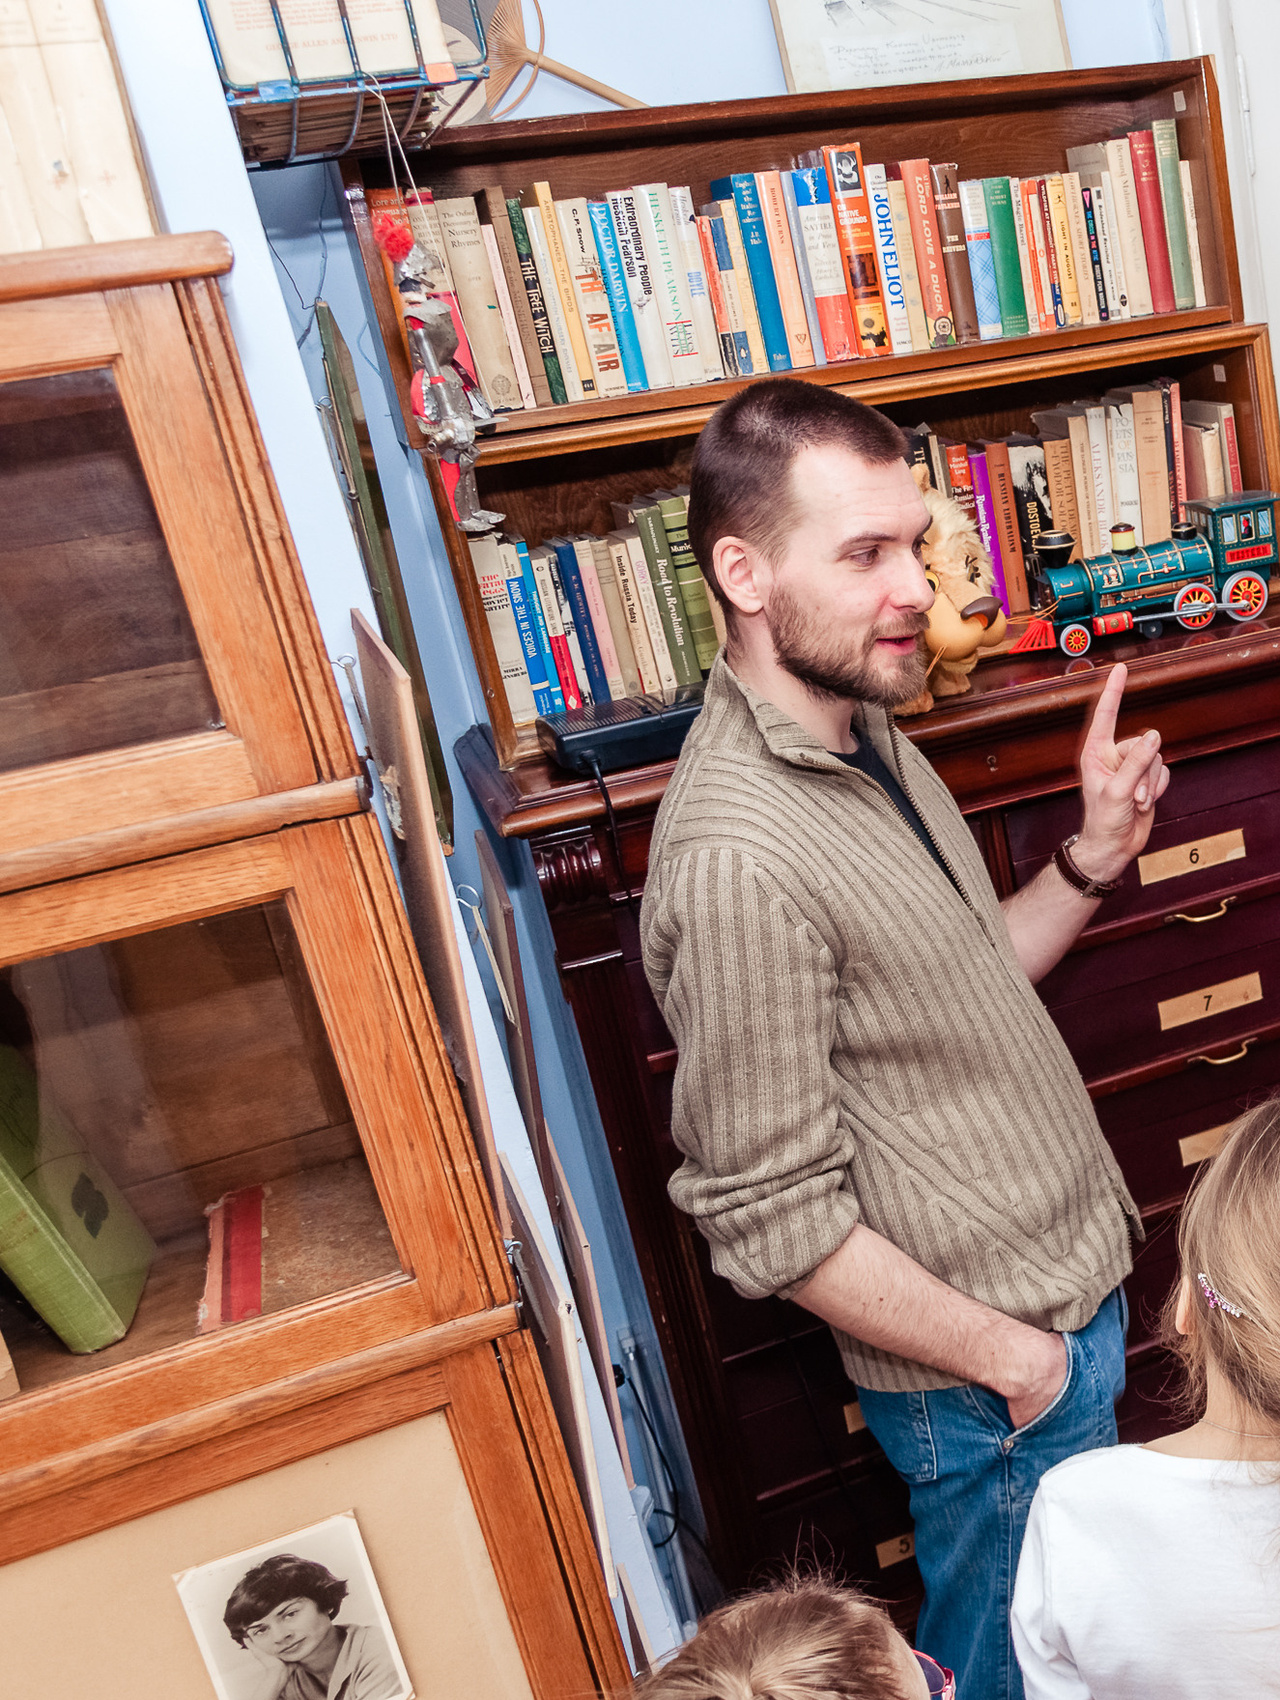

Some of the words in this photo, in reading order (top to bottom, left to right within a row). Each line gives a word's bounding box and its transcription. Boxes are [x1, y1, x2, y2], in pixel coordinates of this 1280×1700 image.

[266, 40, 298, 51] GEOGE
[302, 38, 328, 47] ALLEN
[381, 33, 399, 41] LTD
[1116, 143, 1128, 179] Bernard
[1122, 178, 1135, 219] Malamud
[371, 197, 388, 208] Lore
[390, 196, 405, 206] and
[914, 176, 928, 216] LORD
[934, 192, 958, 201] WILLIAM
[934, 201, 961, 211] FAULKNER
[1040, 184, 1048, 212] WILDFIRE
[455, 210, 476, 218] Oxford
[770, 187, 780, 217] ROBERT
[776, 220, 786, 245] BURNS
[838, 209, 860, 219] NATIVE
[839, 215, 868, 226] GROUNDS
[873, 193, 896, 248] JOHN
[1014, 200, 1023, 223] Magic
[1044, 211, 1050, 219] AT
[448, 227, 478, 238] Nursery
[723, 206, 740, 242] Ogden
[804, 223, 834, 232] SATIRE
[1017, 224, 1027, 247] Barrel
[1045, 219, 1056, 250] MIDNIGHT
[1098, 204, 1107, 237] Brideshead
[1103, 237, 1111, 265] Revisited
[451, 238, 481, 249] Rhymes
[577, 229, 587, 254] Snow
[622, 196, 646, 264] Extraordinary
[638, 264, 654, 296] People
[922, 219, 936, 256] LOVE
[942, 244, 967, 253] REIVERS
[946, 234, 959, 242] THE
[1076, 226, 1085, 249] SHORT
[596, 206, 616, 260] DOCTOR
[609, 262, 630, 314] DARWIN
[648, 192, 670, 257] HESKETH
[662, 260, 684, 322] PEARSON
[731, 245, 745, 269] Nash
[1050, 252, 1058, 267] MARY
[1060, 220, 1068, 240] LIGHT
[1064, 253, 1074, 280] AUGUST
[520, 258, 533, 281] THE
[928, 260, 937, 270] A
[1079, 251, 1090, 281] STORIES
[687, 270, 706, 299] DOYLE
[882, 249, 906, 311] ELIOT
[526, 287, 544, 314] TREE
[564, 287, 574, 313] BIRDS
[930, 274, 945, 313] DUCK
[533, 318, 554, 354] WITCH
[585, 312, 621, 373] AFFAIR
[1115, 416, 1132, 428] PO-
[1115, 428, 1133, 439] ETS
[913, 447, 926, 463] TH
[1060, 444, 1071, 465] THE
[1117, 440, 1131, 450] OF
[1052, 454, 1065, 498] FYODOR
[1091, 443, 1106, 515] ALEKSANDR
[1118, 462, 1135, 473] SIA
[951, 486, 962, 494] The
[997, 472, 1010, 506] RUSSIAN
[1063, 469, 1075, 503] PETTY
[975, 494, 990, 525] Russian
[1002, 506, 1018, 554] LIBERALISM
[1026, 501, 1042, 555] DOSTOEV
[1068, 508, 1079, 541] DEMO
[1098, 518, 1110, 549] BLOK
[670, 542, 693, 554] Munic
[980, 523, 992, 553] Realism
[616, 554, 627, 577] Inside
[1229, 546, 1268, 561] WESTERN
[634, 560, 650, 585] GORKY
[656, 558, 673, 585] Road
[508, 580, 524, 604] SNOW
[540, 578, 550, 598] RUSSIAN
[621, 577, 633, 604] Russia
[663, 585, 673, 598] to
[515, 603, 528, 621] THE
[532, 590, 543, 615] THOUGHT
[540, 626, 552, 654] LANGUAGE
[627, 602, 639, 625] Today
[665, 597, 686, 648] Revolution
[519, 621, 530, 631] IN
[522, 631, 538, 660] VOICES
[1189, 848, 1200, 864] 6
[1202, 994, 1213, 1012] 7
[899, 1538, 911, 1554] 5
